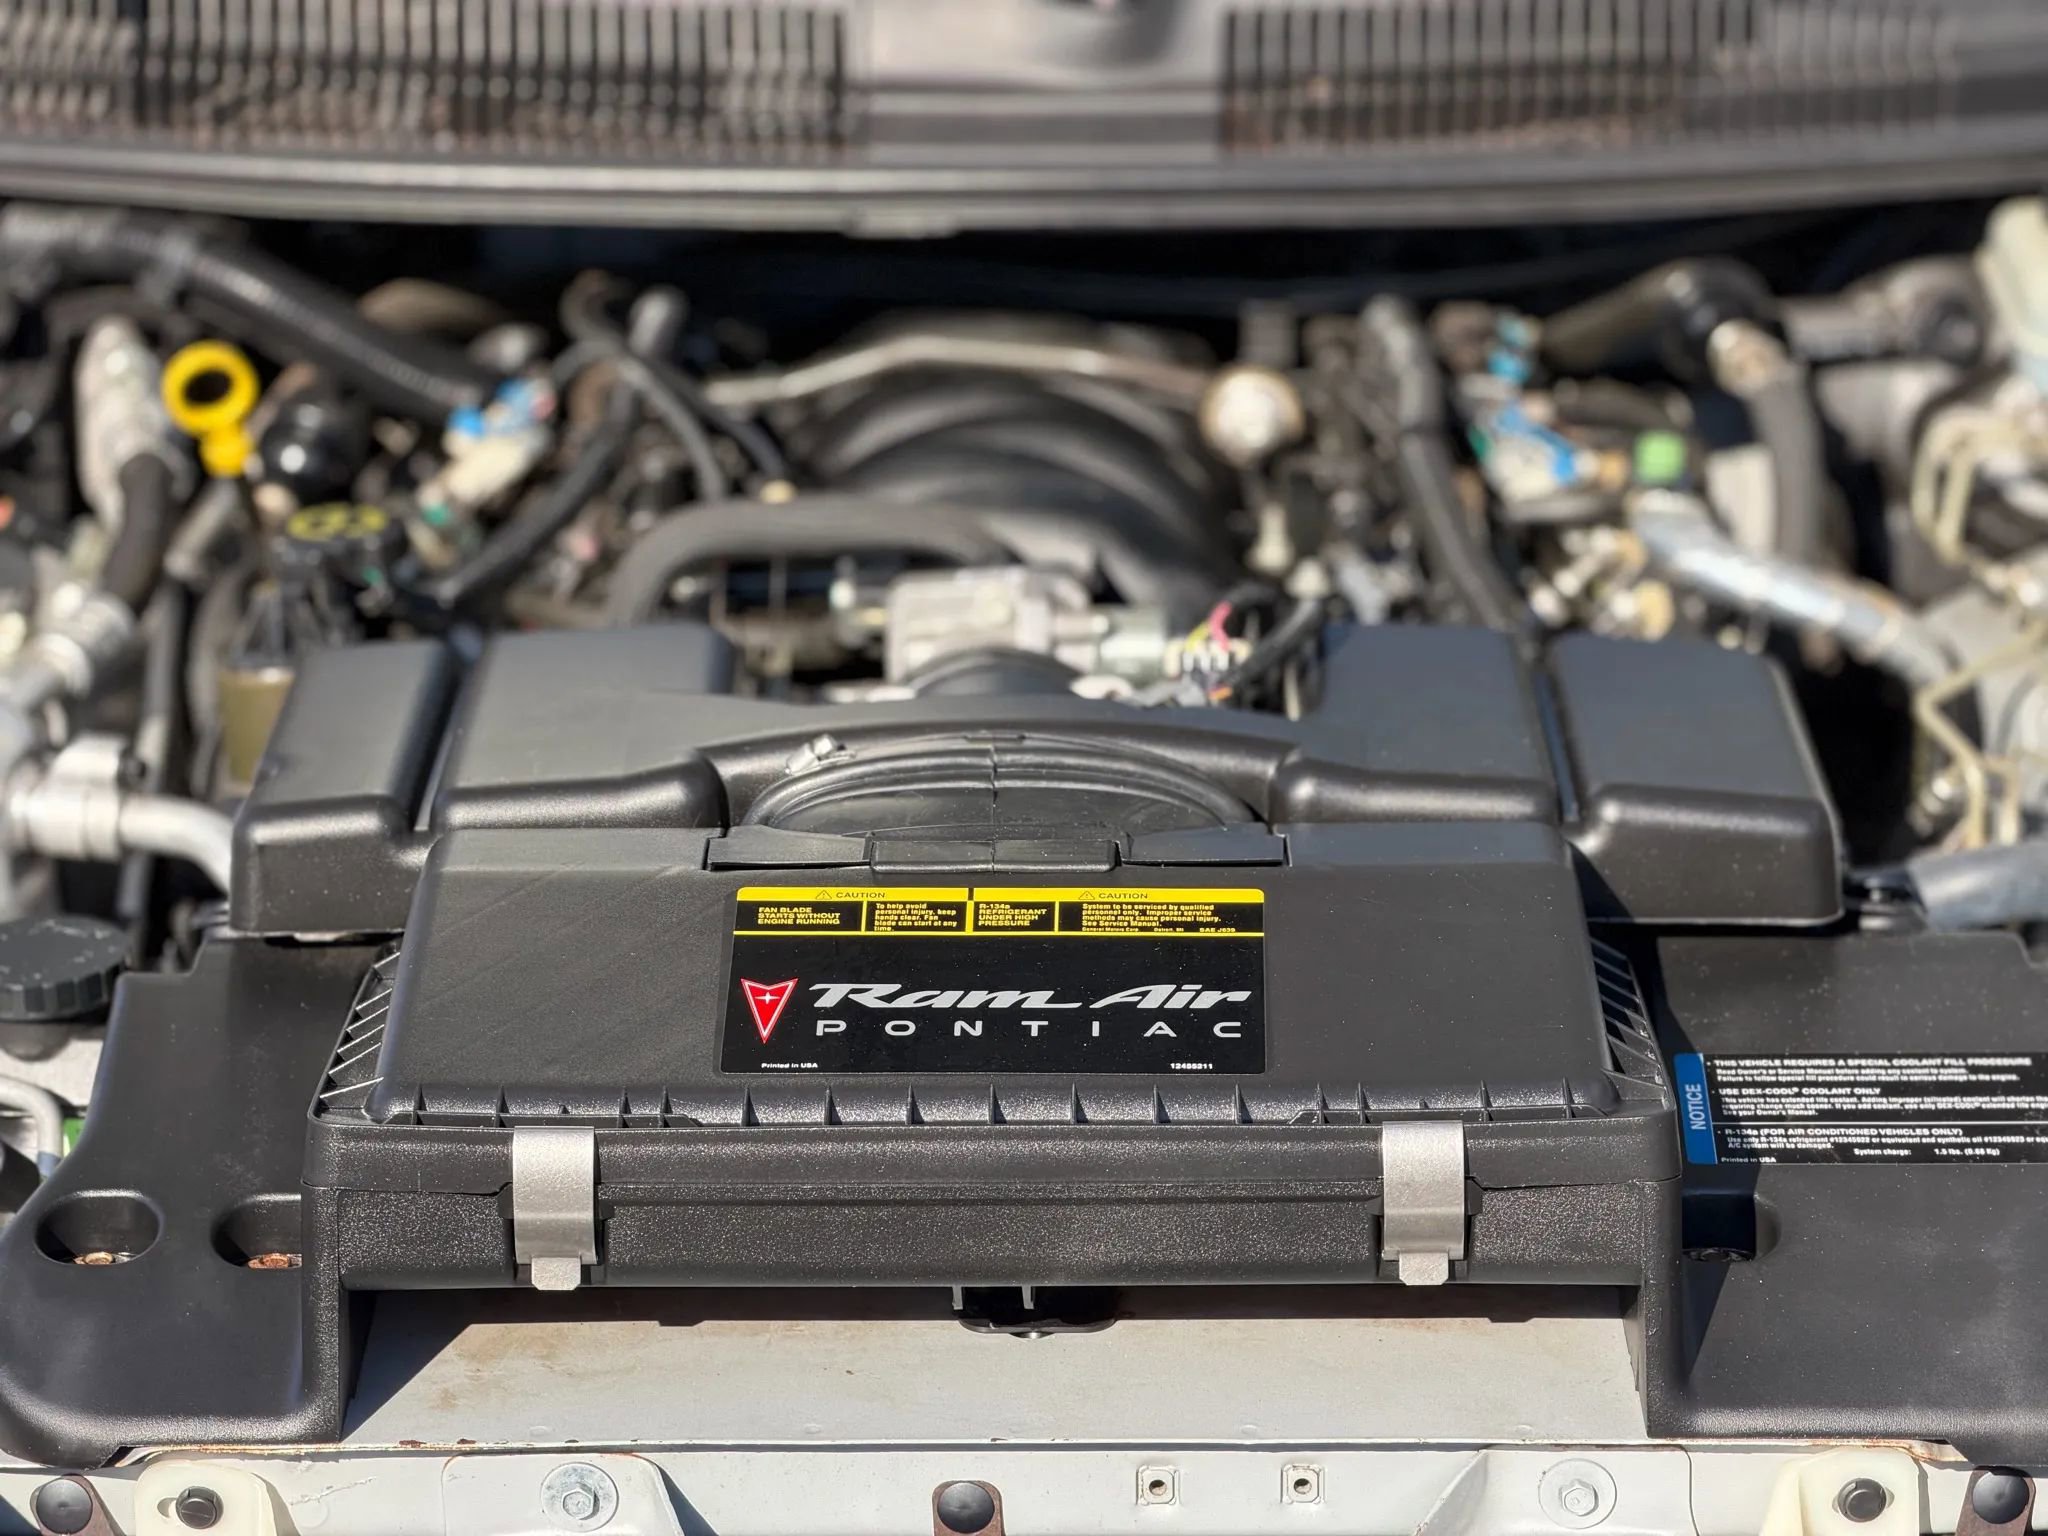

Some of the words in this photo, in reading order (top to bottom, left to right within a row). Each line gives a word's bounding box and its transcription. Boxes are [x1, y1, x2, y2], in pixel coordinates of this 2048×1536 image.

[808, 983, 1082, 1008] Ram
[1090, 983, 1254, 1008] Air
[815, 1020, 1242, 1037] PONTIAC
[1685, 1083, 1707, 1130] NOTICE
[1931, 1128, 1963, 1136] ONLY)
